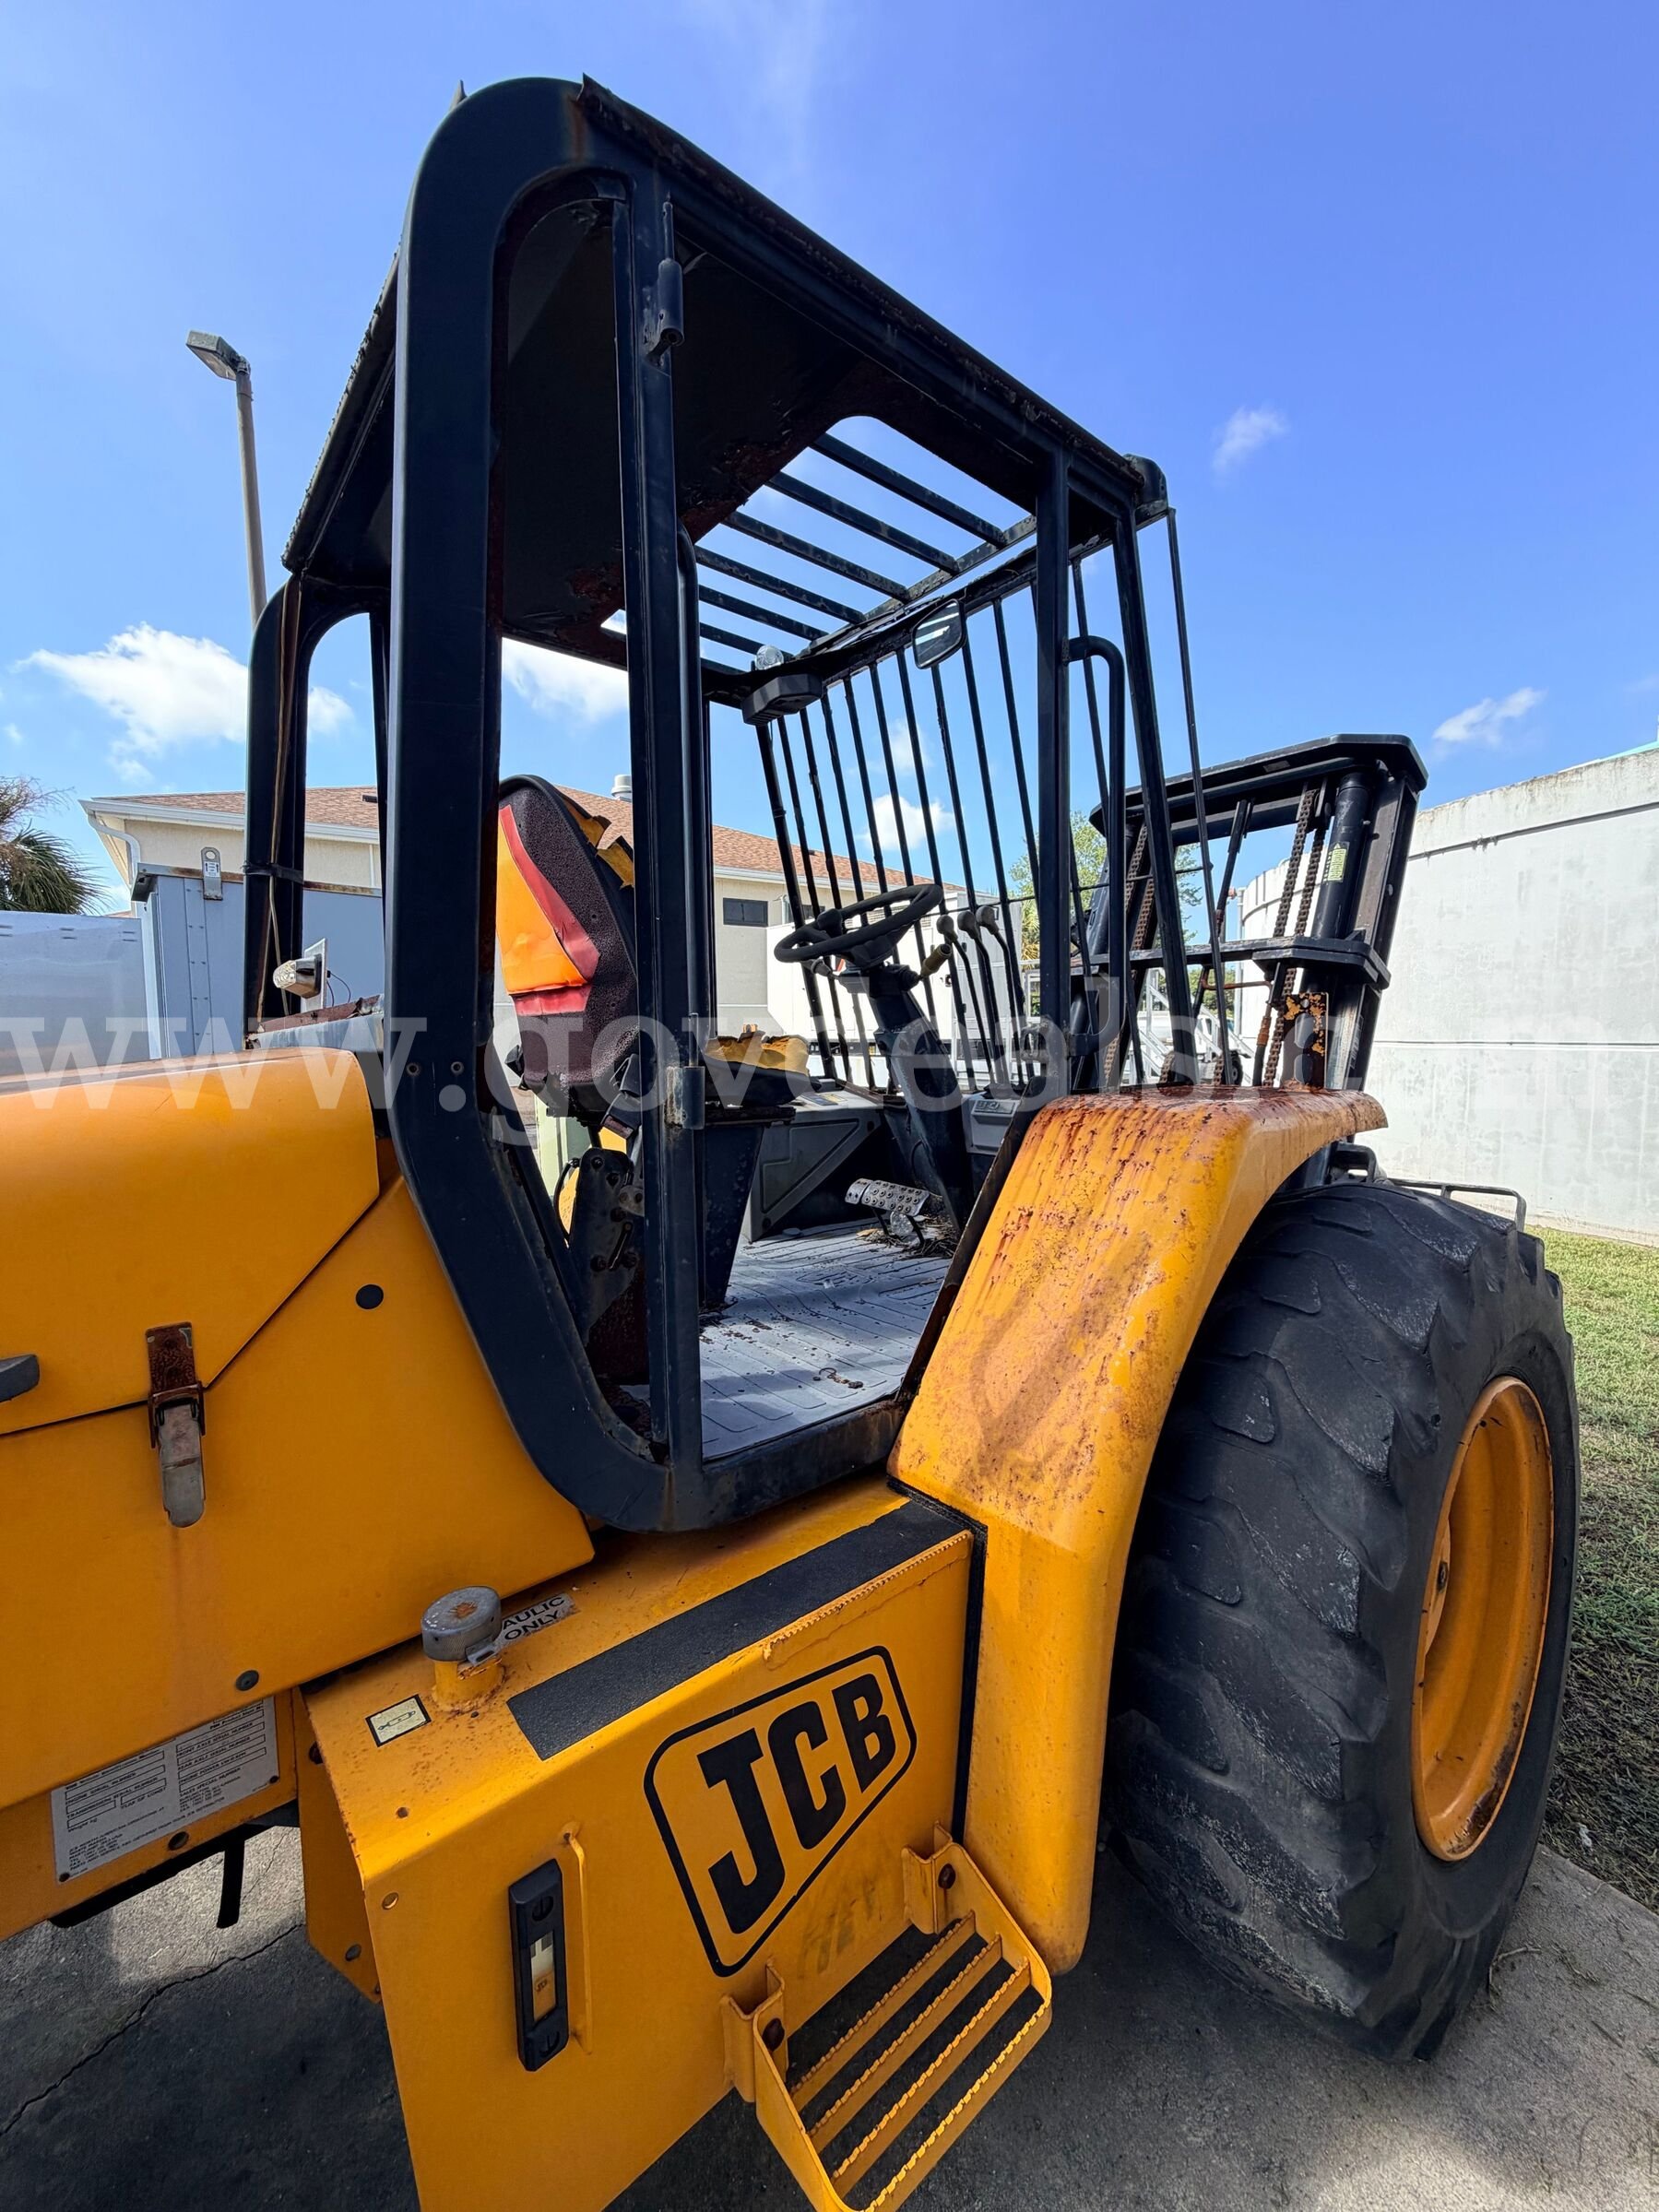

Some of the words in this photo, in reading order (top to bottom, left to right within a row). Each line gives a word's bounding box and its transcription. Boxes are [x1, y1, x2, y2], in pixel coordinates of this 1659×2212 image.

[502, 1596, 565, 1631] AULIC
[504, 1610, 559, 1640] ONLY
[696, 1673, 896, 1934] JCB
